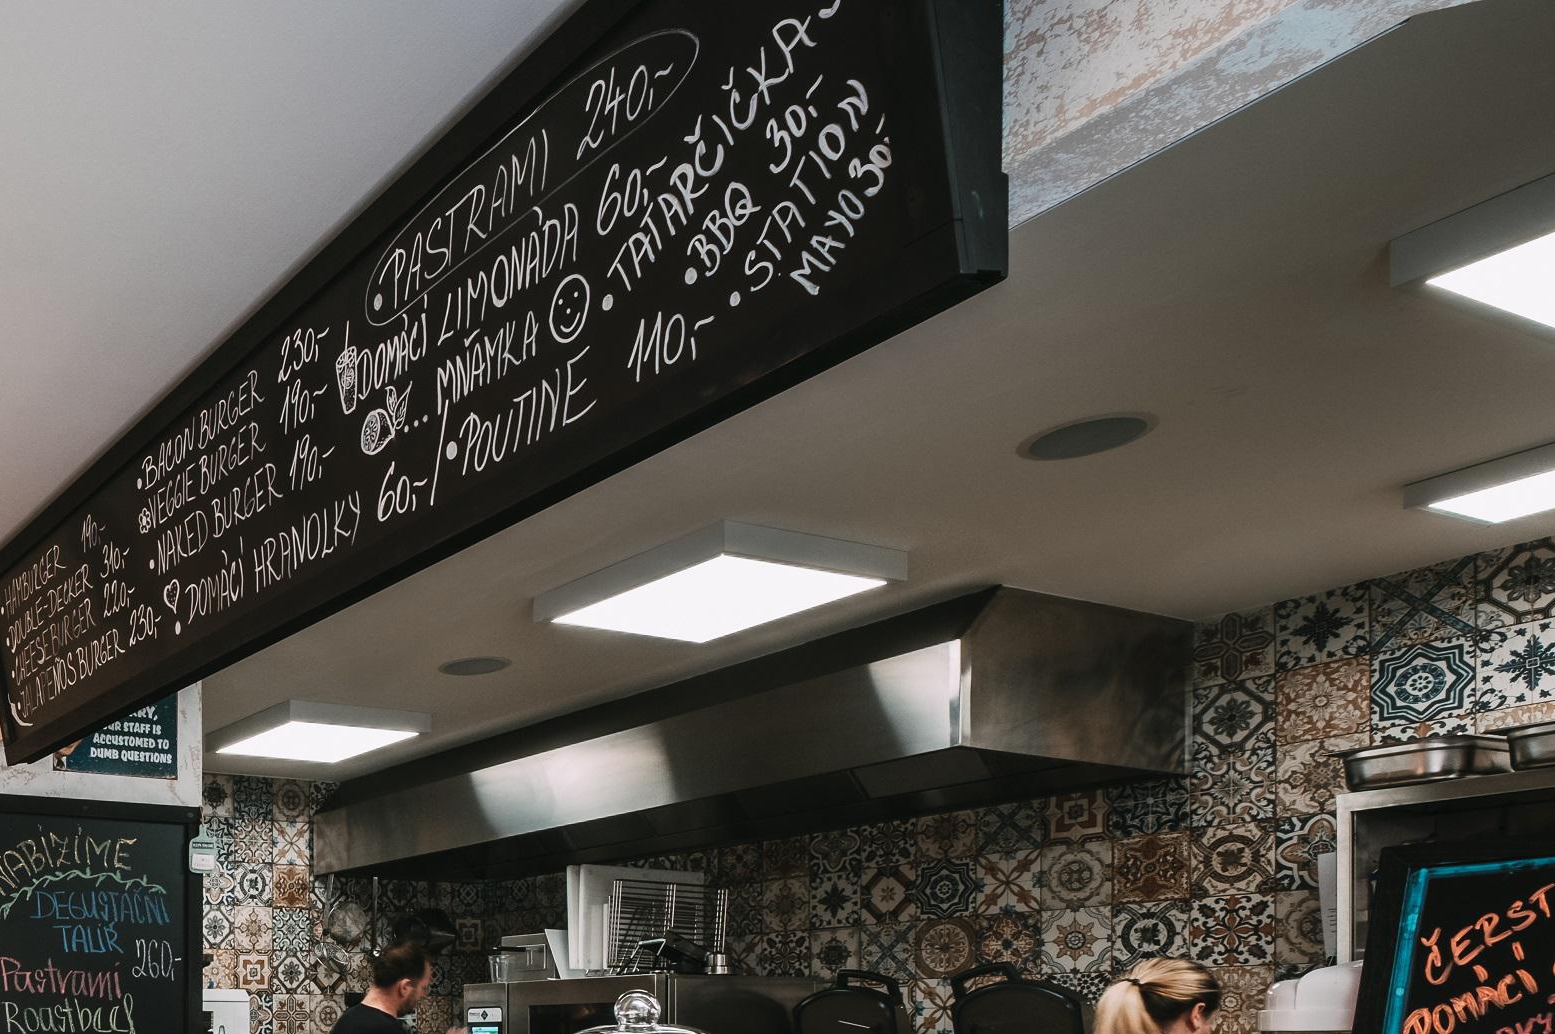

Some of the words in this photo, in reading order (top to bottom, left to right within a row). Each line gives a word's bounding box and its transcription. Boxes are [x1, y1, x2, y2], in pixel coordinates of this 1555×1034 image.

[379, 129, 548, 309] PASTRAMI
[687, 182, 761, 278] BBQ
[745, 79, 869, 292] STATION
[790, 188, 864, 296] MAYO
[142, 416, 195, 490] BACON
[197, 369, 265, 450] BURGER
[459, 345, 597, 476] POUTINE
[148, 463, 196, 530] VEGGIE
[200, 422, 267, 495] BURGER
[156, 510, 209, 575] NAKED
[211, 463, 284, 538] BURGER
[4, 545, 67, 620] HAMBURGER
[253, 490, 361, 594] HRANOLKY
[8, 563, 94, 654] DOUBLE-DECKER
[14, 598, 96, 687] CHEESEBURGER
[75, 628, 126, 681] BURGER
[90, 747, 119, 760] DUMB
[121, 749, 172, 764] QUESTIONS
[93, 732, 156, 748] ACCUSTOMED
[157, 738, 170, 750] TO
[123, 722, 151, 734] STAFF
[152, 724, 162, 735] IS
